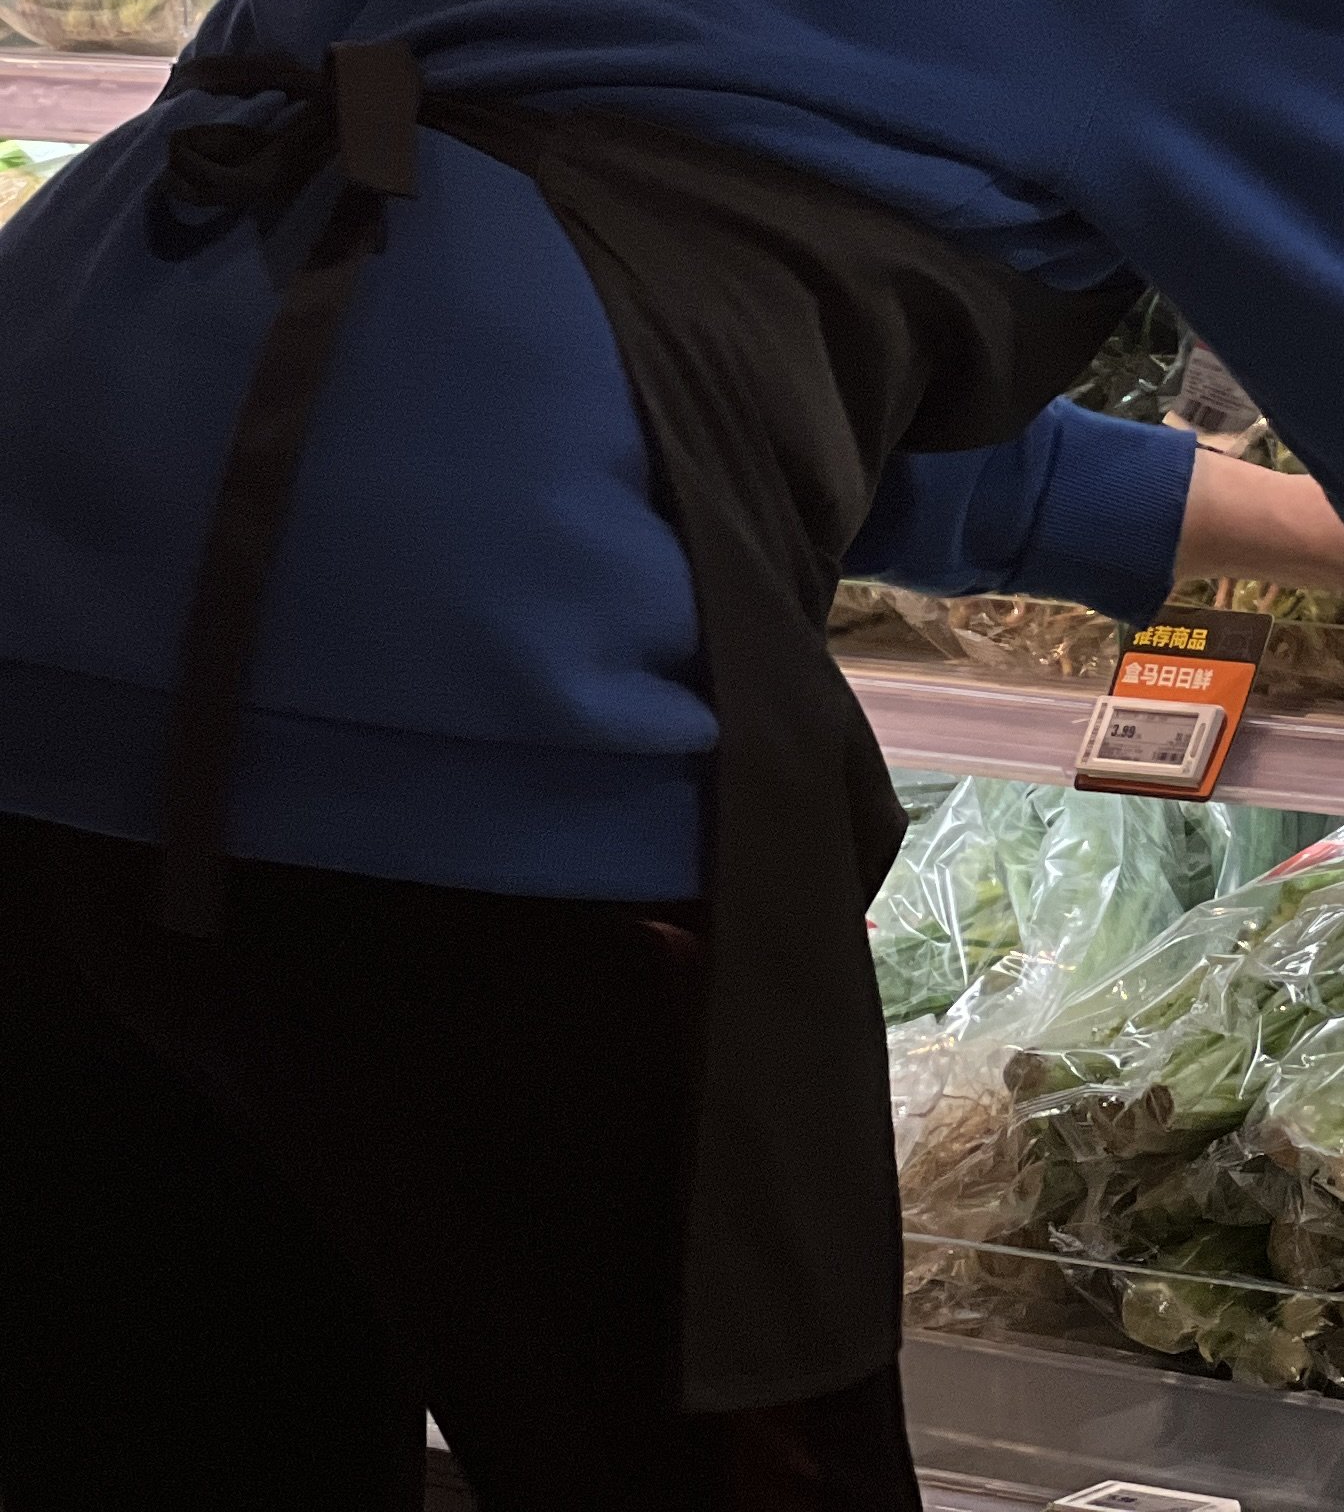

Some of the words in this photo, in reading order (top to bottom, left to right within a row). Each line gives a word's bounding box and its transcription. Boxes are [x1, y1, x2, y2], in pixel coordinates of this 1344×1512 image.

[1133, 625, 1208, 651] 推荐商品
[1121, 662, 1214, 690] 盒马日日鲜
